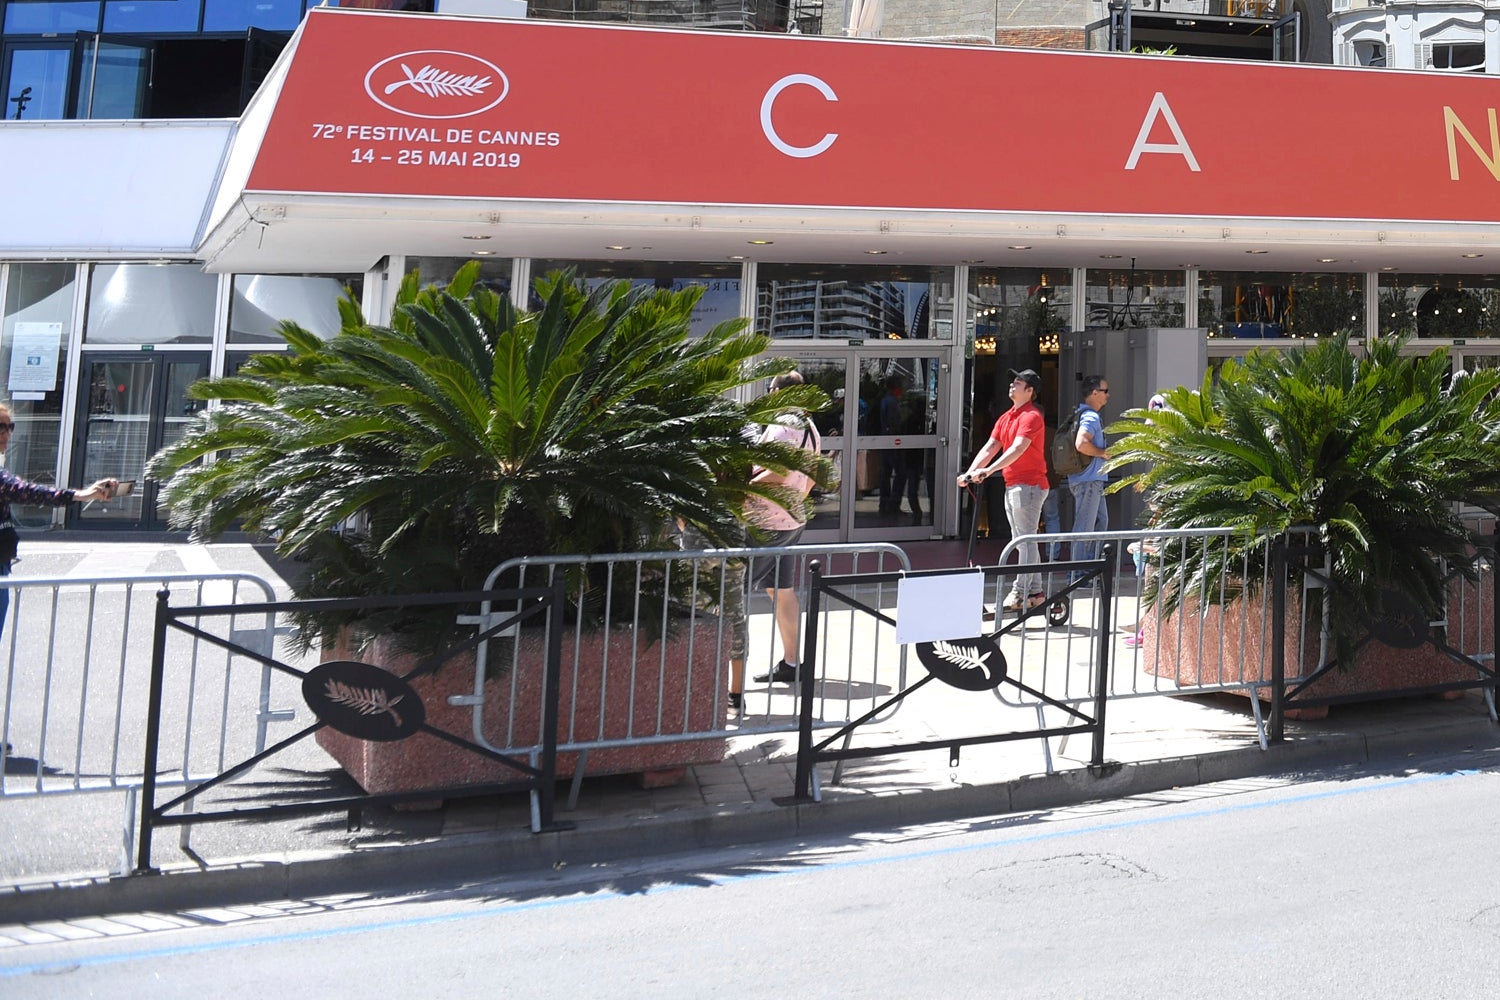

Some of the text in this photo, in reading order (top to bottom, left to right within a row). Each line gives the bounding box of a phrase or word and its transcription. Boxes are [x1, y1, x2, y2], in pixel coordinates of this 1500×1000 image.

[346, 125, 442, 143] FESTIVAL
[446, 129, 473, 144] DE
[477, 130, 560, 146] CANNES
[351, 148, 375, 164] 14
[397, 149, 423, 165] 25
[428, 150, 467, 167] MAI
[472, 152, 521, 168] 2019
